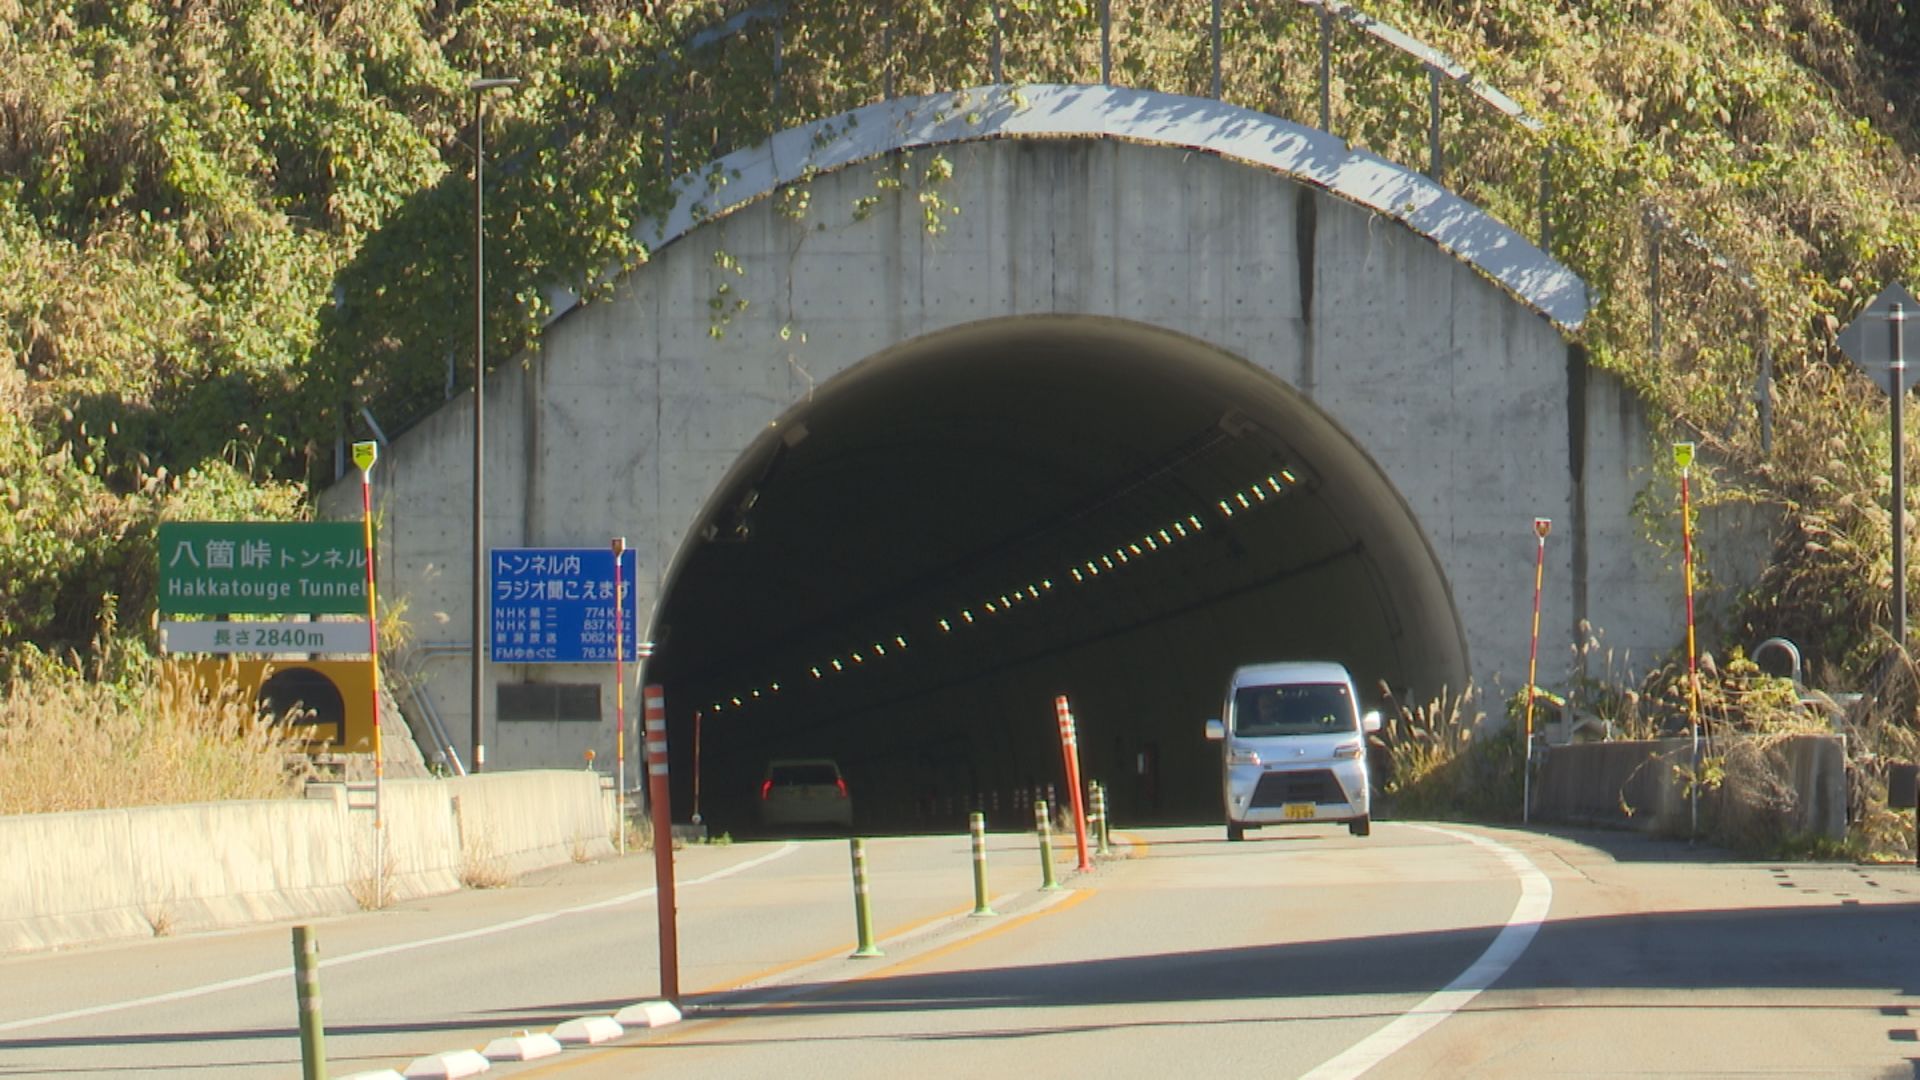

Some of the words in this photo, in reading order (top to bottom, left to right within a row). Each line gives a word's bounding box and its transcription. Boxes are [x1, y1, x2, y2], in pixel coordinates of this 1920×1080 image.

[169, 538, 367, 569] 八箇峠トンネル
[498, 554, 580, 575] トンネル内
[168, 578, 291, 600] Hakkatouge
[299, 578, 368, 597] Tunnel
[214, 629, 324, 646] 長さ2840m
